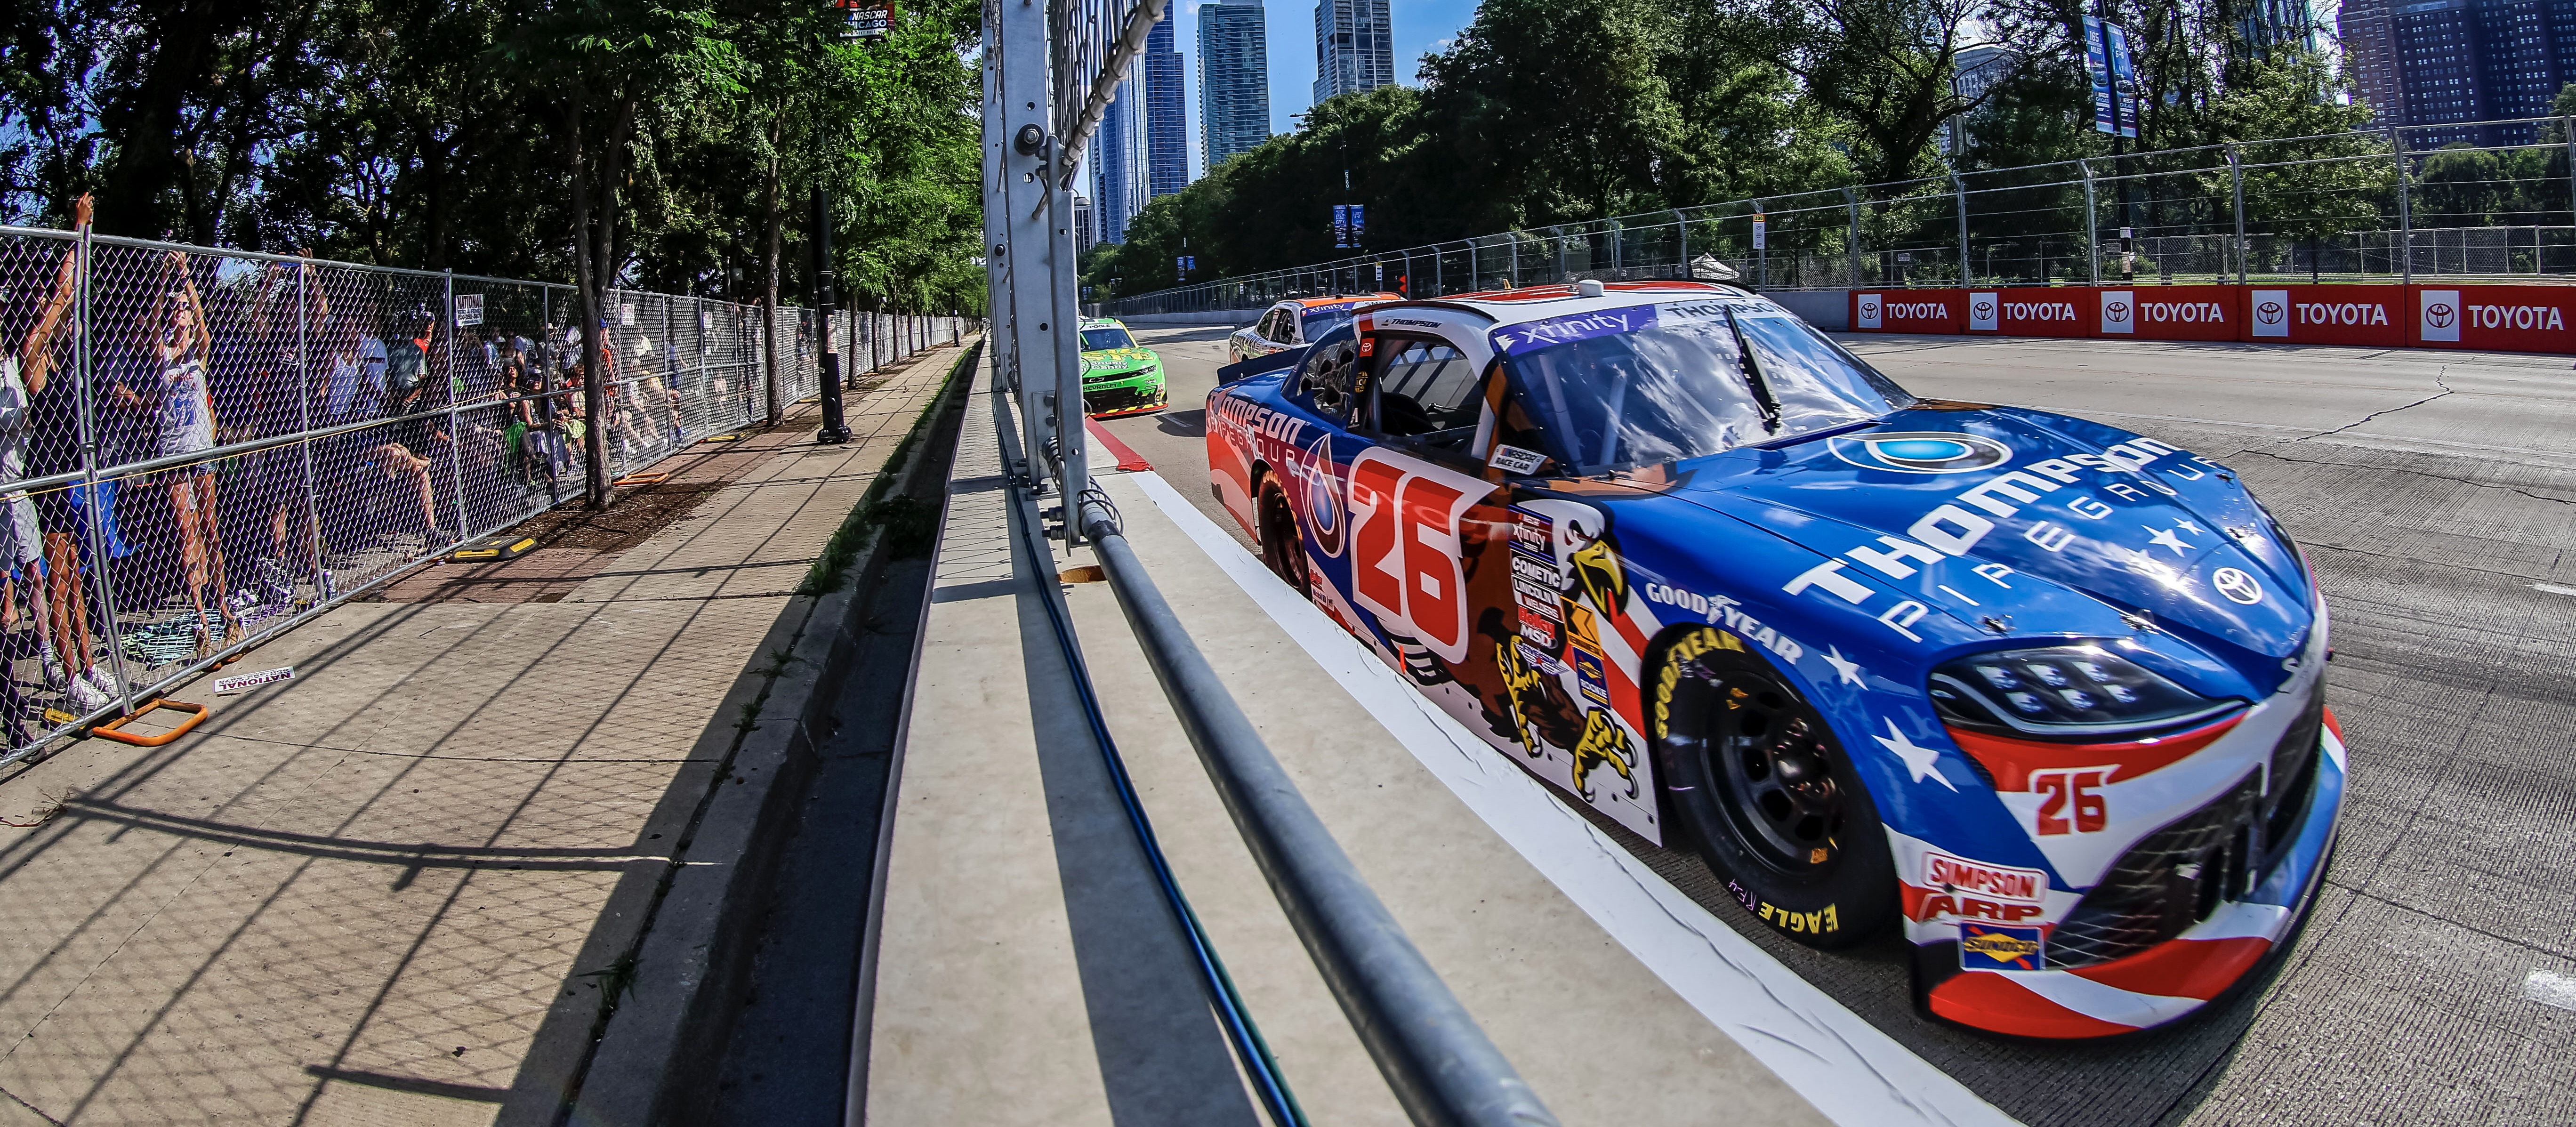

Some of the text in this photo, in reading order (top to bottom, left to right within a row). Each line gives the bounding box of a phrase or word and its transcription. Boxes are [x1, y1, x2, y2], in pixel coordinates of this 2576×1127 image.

[844, 19, 887, 29] HICAGO
[852, 10, 888, 21] NASCAR
[457, 295, 483, 309] NATIONAL
[1309, 303, 1345, 314] xfinity
[1886, 303, 1948, 319] TOYOTA
[2003, 303, 2076, 321] TOYOTA
[2141, 303, 2223, 322] TOYOTA
[2296, 303, 2388, 325] TOYOTA
[1391, 319, 1443, 329] THOMPSON
[1518, 314, 1629, 344] xfinity
[2468, 305, 2564, 330] TOYOTA
[1782, 437, 2184, 605] THOMPSON
[1513, 522, 1546, 551] xfinity
[1353, 459, 1465, 648] 26
[1877, 521, 2077, 644] PIPE
[1645, 582, 1803, 665] GOODYEAR
[1520, 624, 1553, 648] MSD
[219, 672, 291, 690] NATIONAL
[2035, 771, 2106, 836] 26
[1931, 858, 2035, 898] SIMPSON
[1758, 902, 1839, 934] EAGLE
[1922, 896, 2043, 921] ARP
